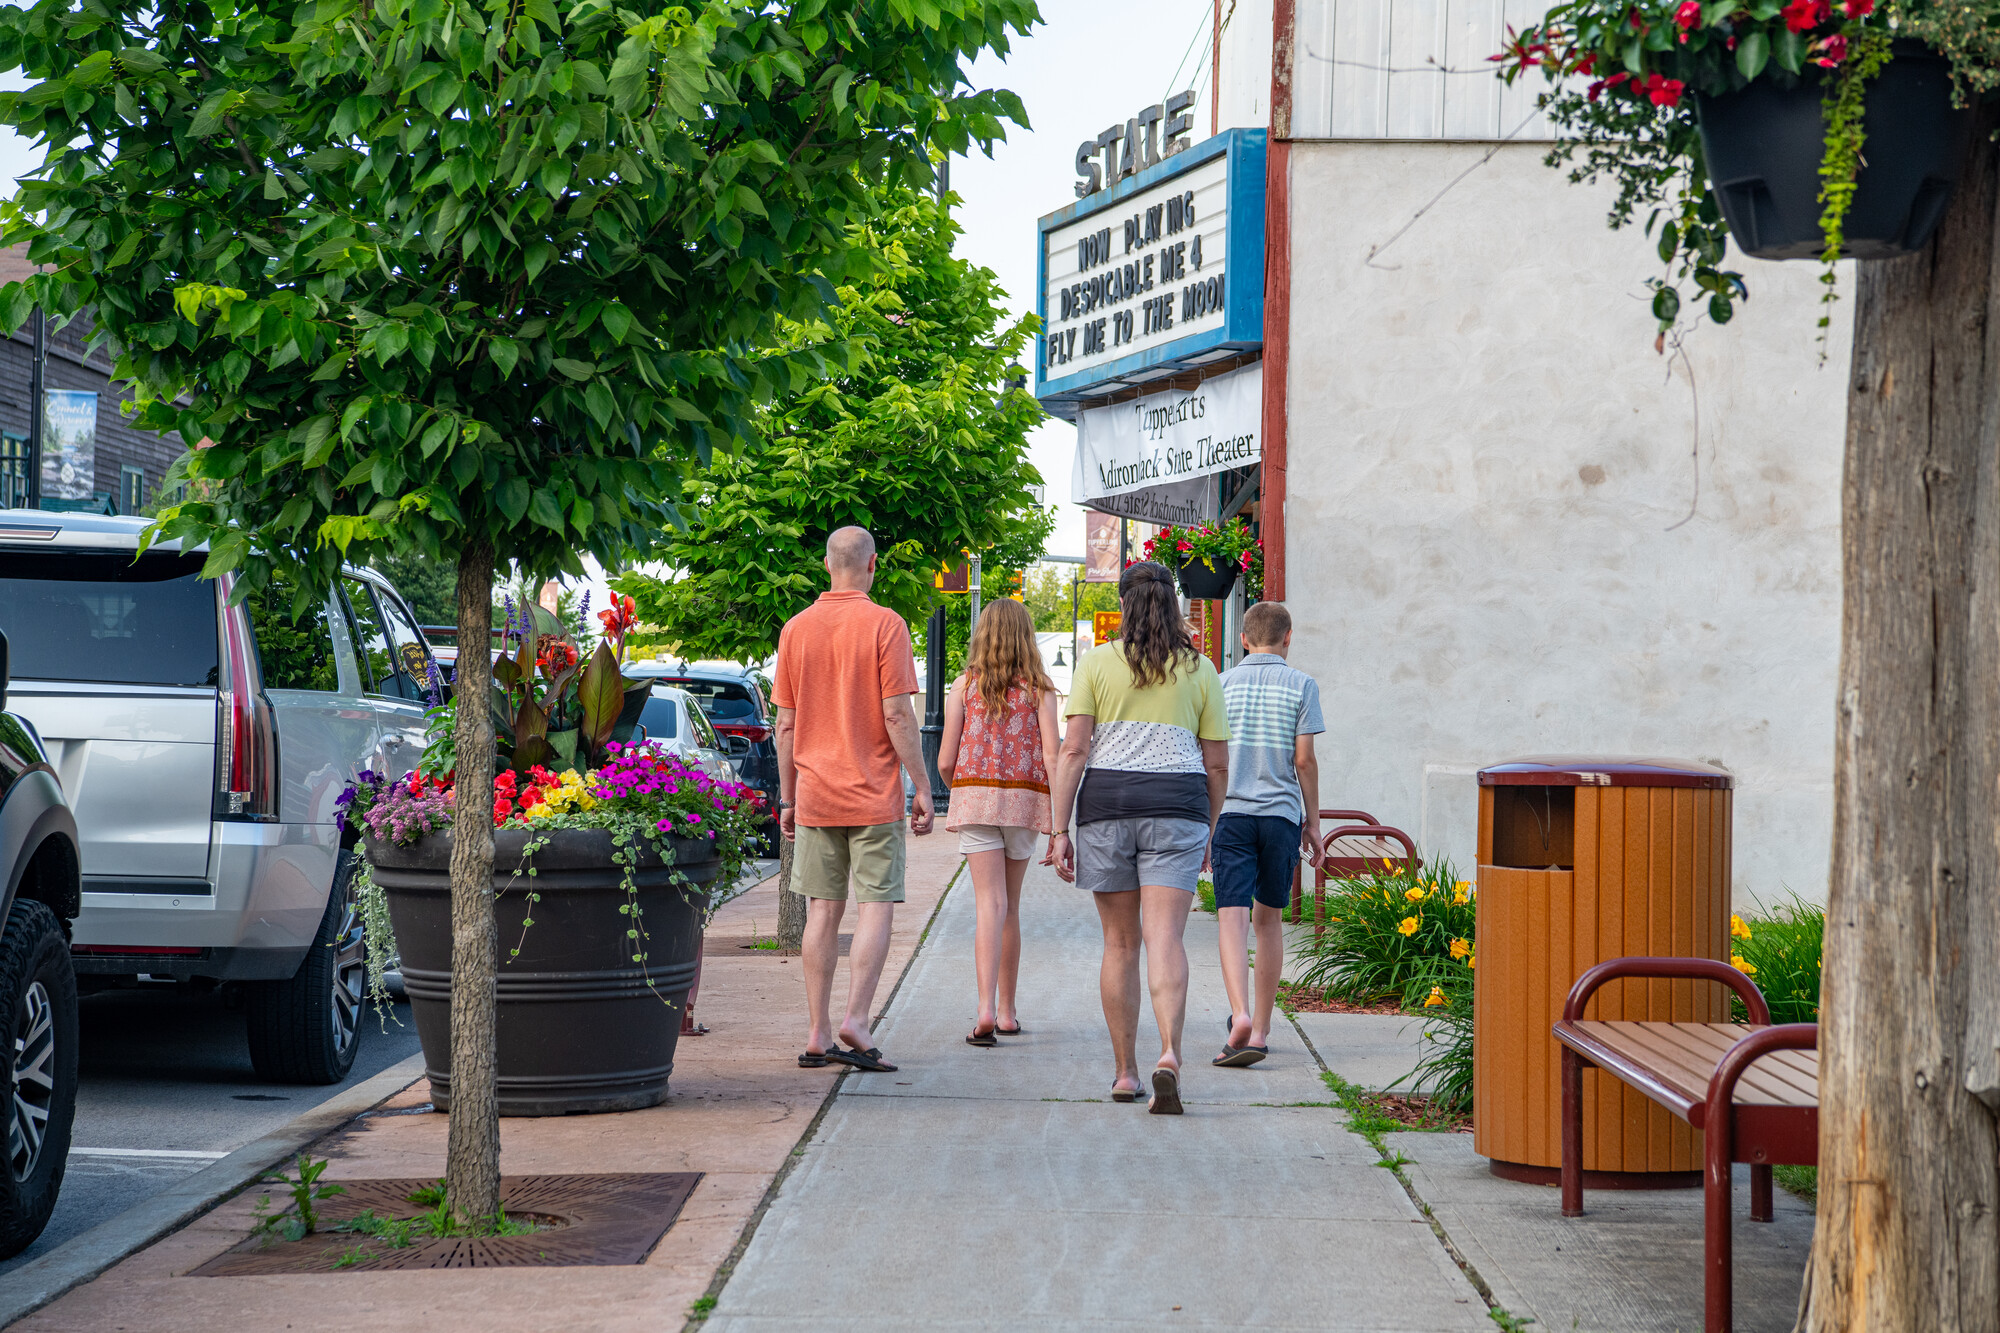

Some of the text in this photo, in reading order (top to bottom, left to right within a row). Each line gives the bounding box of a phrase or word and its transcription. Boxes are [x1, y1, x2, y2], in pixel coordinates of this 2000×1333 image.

[1075, 90, 1196, 198] STATE
[1078, 190, 1195, 272] NOW PLAYING
[1048, 273, 1225, 368] FLY ME TO THE MOON
[1060, 234, 1202, 321] DESPICABLE ME 4
[1164, 447, 1193, 476] State
[1197, 434, 1253, 468] Theater
